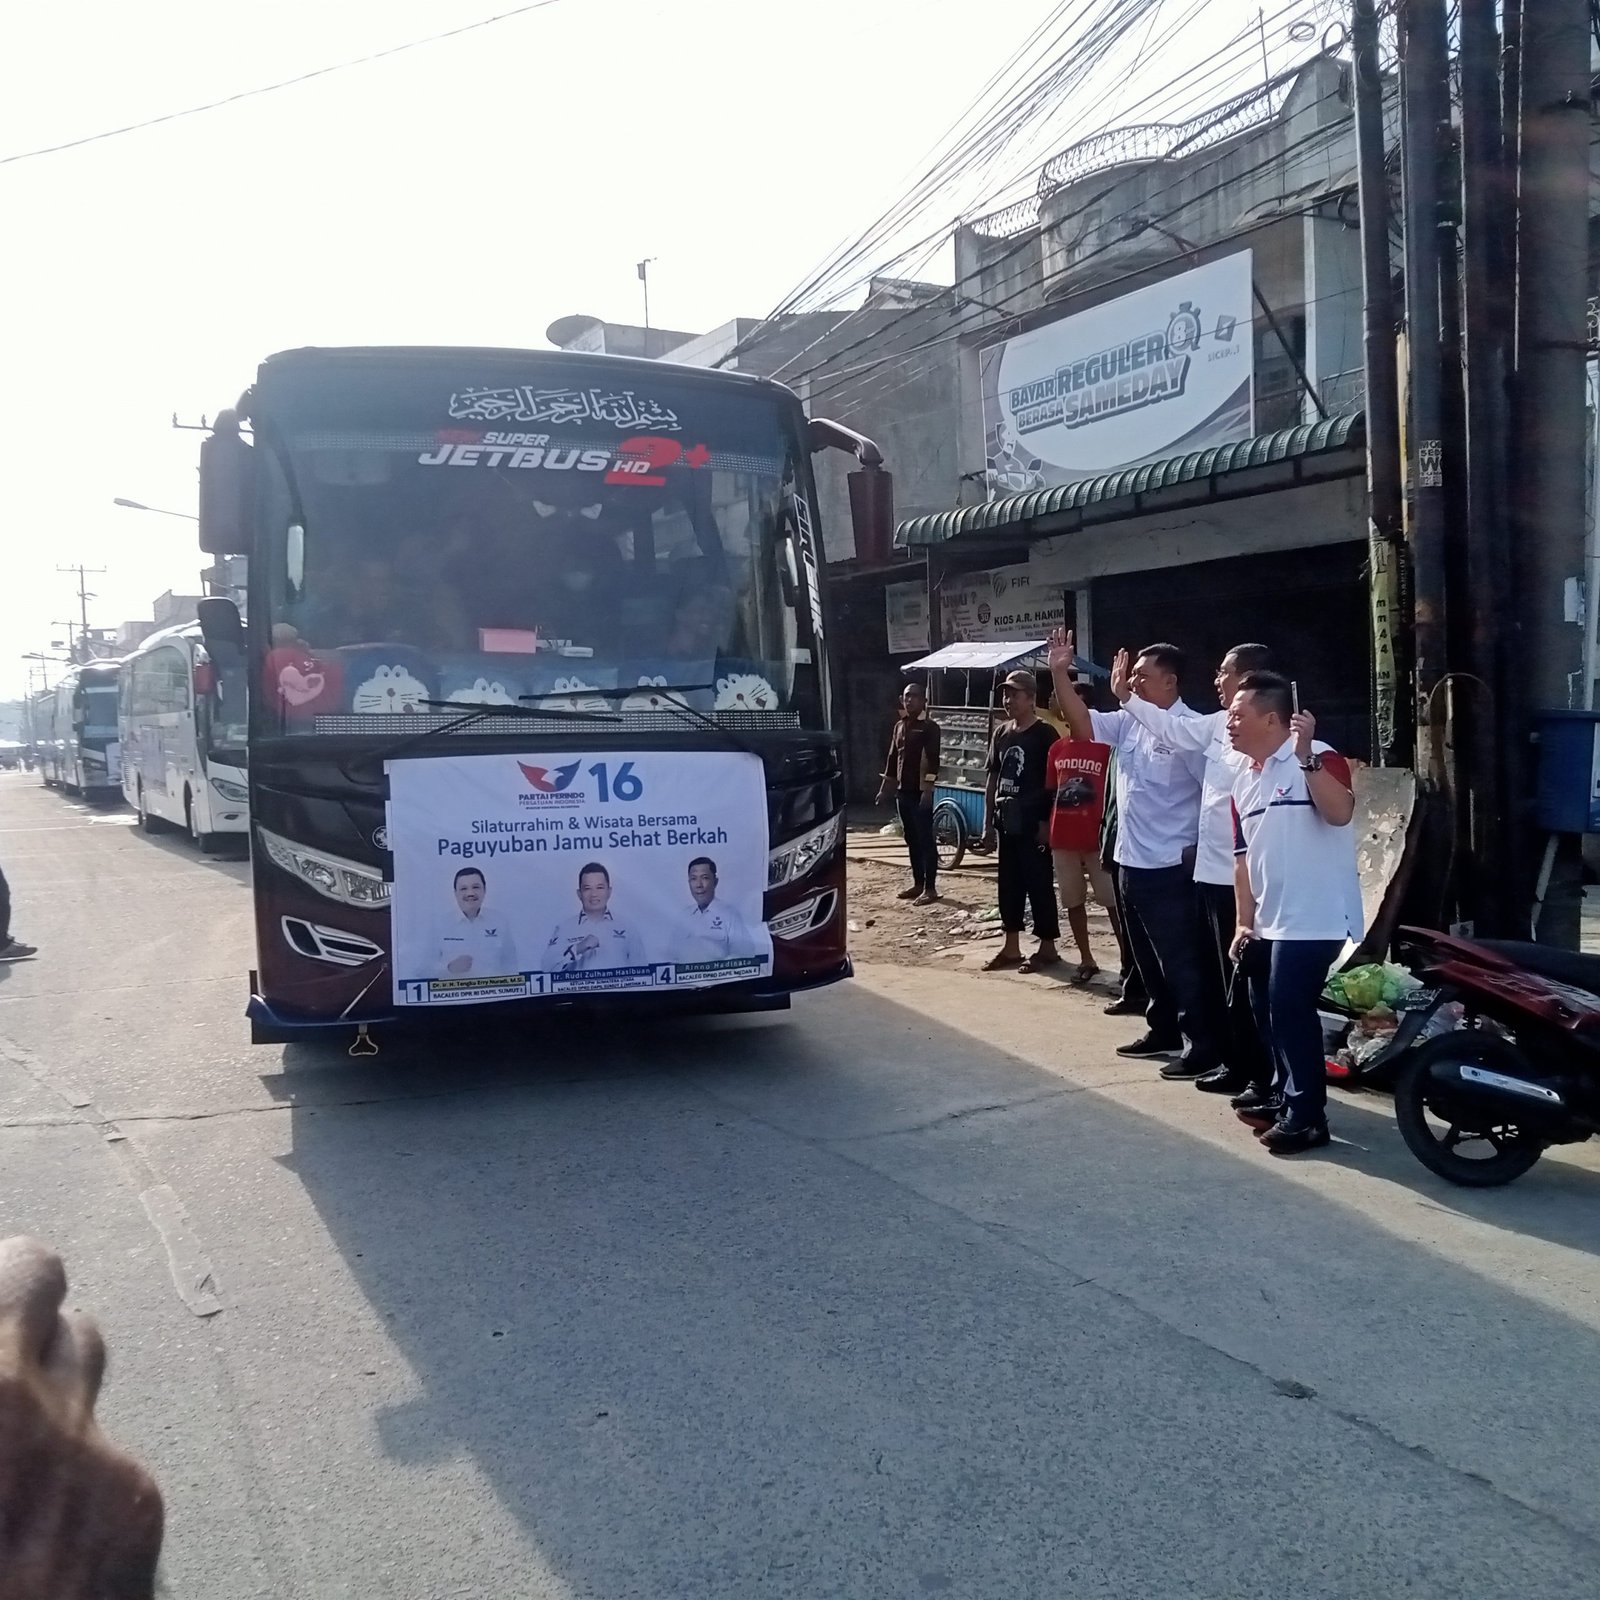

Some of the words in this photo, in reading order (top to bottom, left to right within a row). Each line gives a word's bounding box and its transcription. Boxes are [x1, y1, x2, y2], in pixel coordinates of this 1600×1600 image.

[1011, 377, 1056, 411] BAYAR
[1057, 332, 1165, 397] REGULER
[1018, 401, 1065, 428] BERASA
[1065, 355, 1186, 423] SAMEDAY
[483, 431, 550, 447] SUPER
[418, 443, 612, 472] JETBUS
[612, 460, 651, 474] HD
[994, 615, 1014, 626] KIOS
[1016, 612, 1033, 623] A.R.
[1034, 608, 1065, 621] HAKIM
[588, 761, 644, 802] 16
[518, 793, 549, 801] PARTAI
[550, 792, 585, 800] PERINDO
[471, 817, 564, 834] Silaturrahim
[568, 817, 580, 830] &
[584, 815, 634, 830] Wisata
[638, 813, 698, 828] Bersama
[438, 834, 548, 858] Paguyuban
[552, 832, 603, 851] Jamu
[608, 829, 662, 848] Sehat
[667, 827, 728, 845] Berkah
[565, 971, 583, 979] Rudi
[584, 969, 614, 978] Zulham
[615, 967, 651, 976] Hasibuan
[660, 967, 671, 984] 4
[412, 983, 422, 1002] 1
[535, 975, 544, 993] 1
